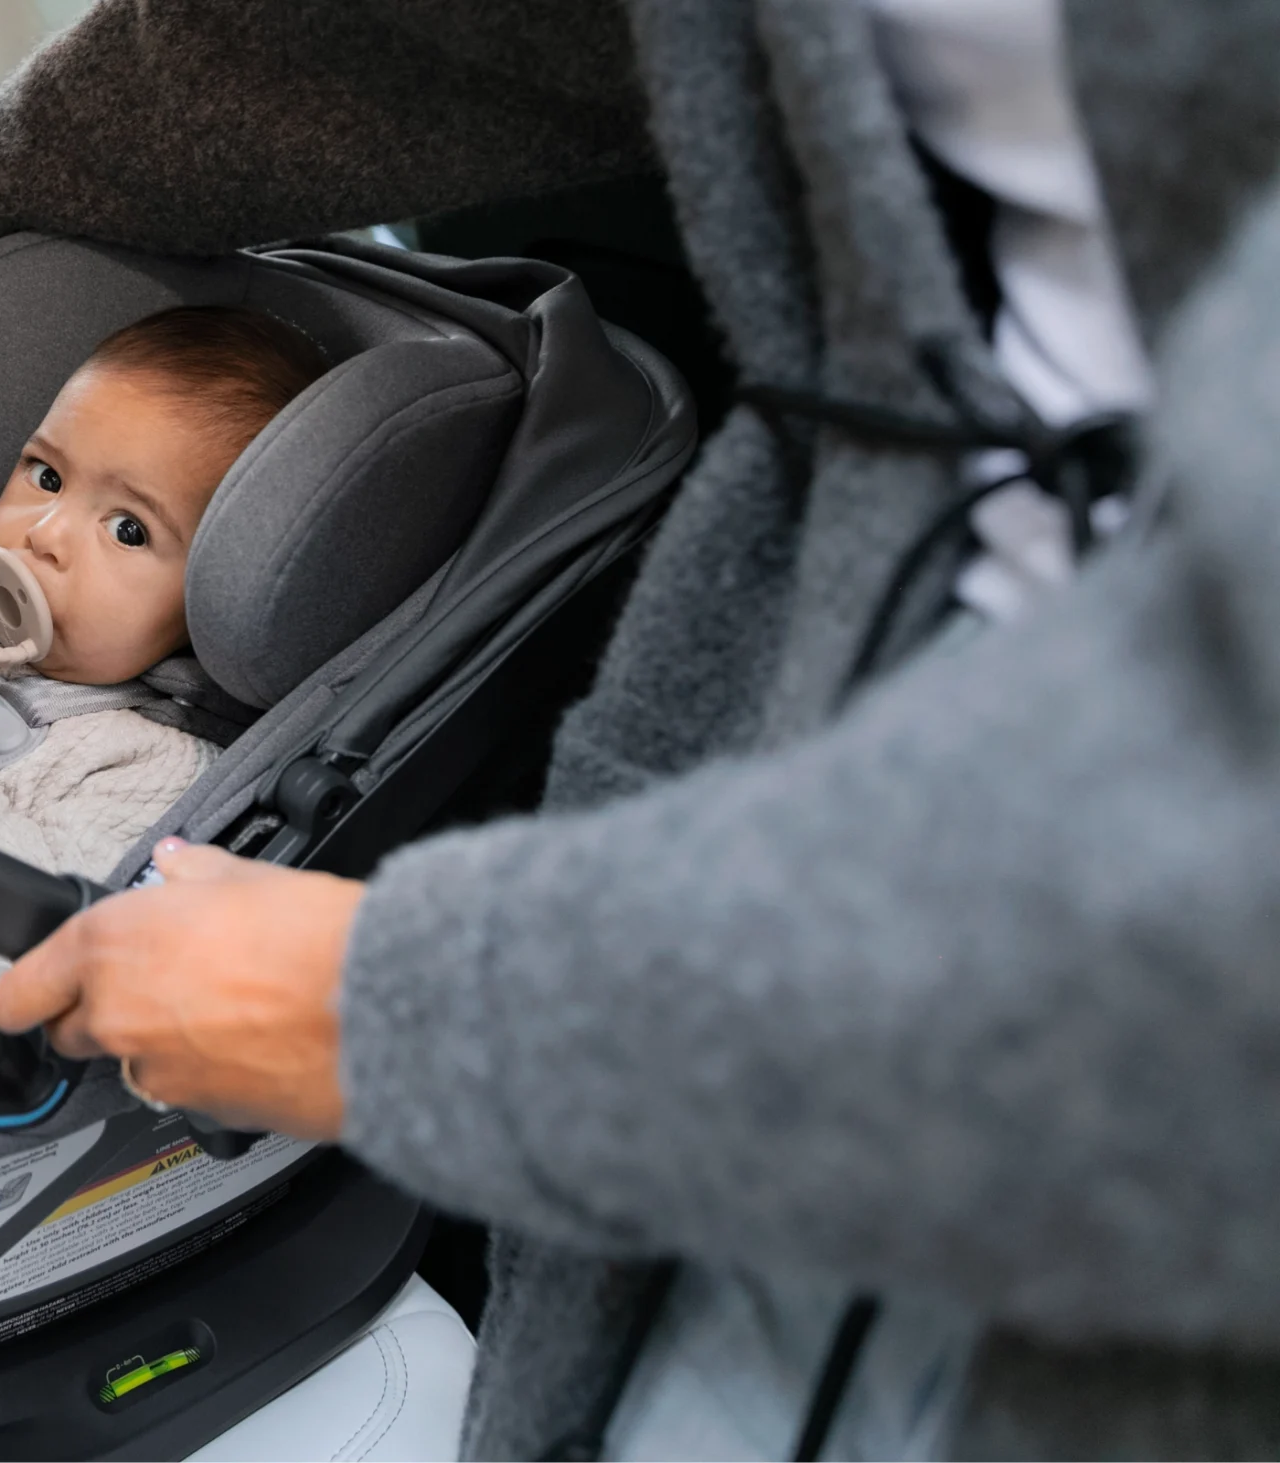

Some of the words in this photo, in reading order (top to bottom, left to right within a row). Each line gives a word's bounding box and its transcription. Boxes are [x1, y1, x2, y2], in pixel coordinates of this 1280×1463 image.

[26, 1237, 39, 1247] Use
[43, 1228, 60, 1239] only
[62, 1218, 79, 1231] with
[81, 1204, 113, 1223] children
[114, 1196, 130, 1208] who
[132, 1184, 154, 1199] weigh
[155, 1170, 188, 1189] between
[3, 1248, 29, 1264] height
[50, 1228, 75, 1243] inches
[27, 1269, 45, 1283] your
[47, 1259, 67, 1273] child
[68, 1244, 100, 1263] restraint
[103, 1235, 119, 1248] with
[121, 1229, 134, 1239] the
